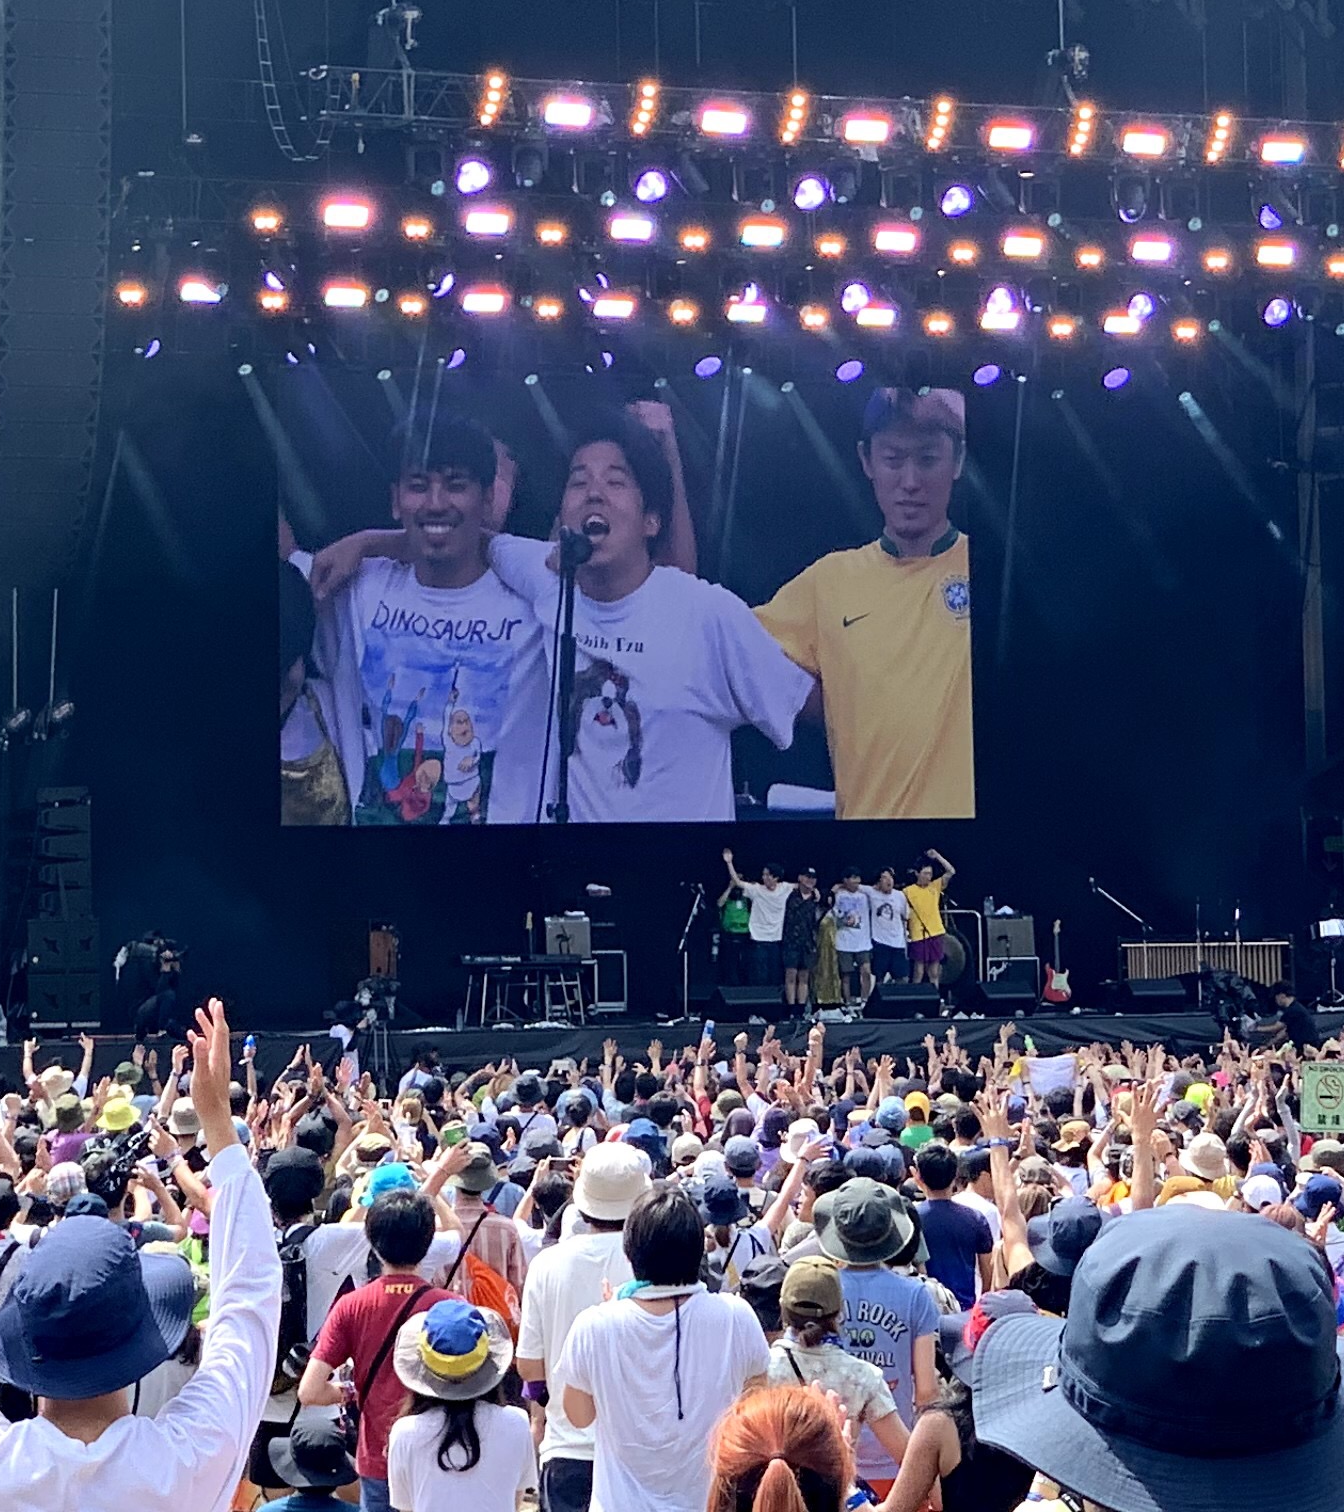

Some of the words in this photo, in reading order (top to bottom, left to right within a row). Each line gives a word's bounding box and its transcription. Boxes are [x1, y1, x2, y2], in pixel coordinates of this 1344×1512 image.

[370, 600, 488, 644] DINOSAUR
[384, 1283, 414, 1294] NTU
[857, 1298, 909, 1343] ROCK
